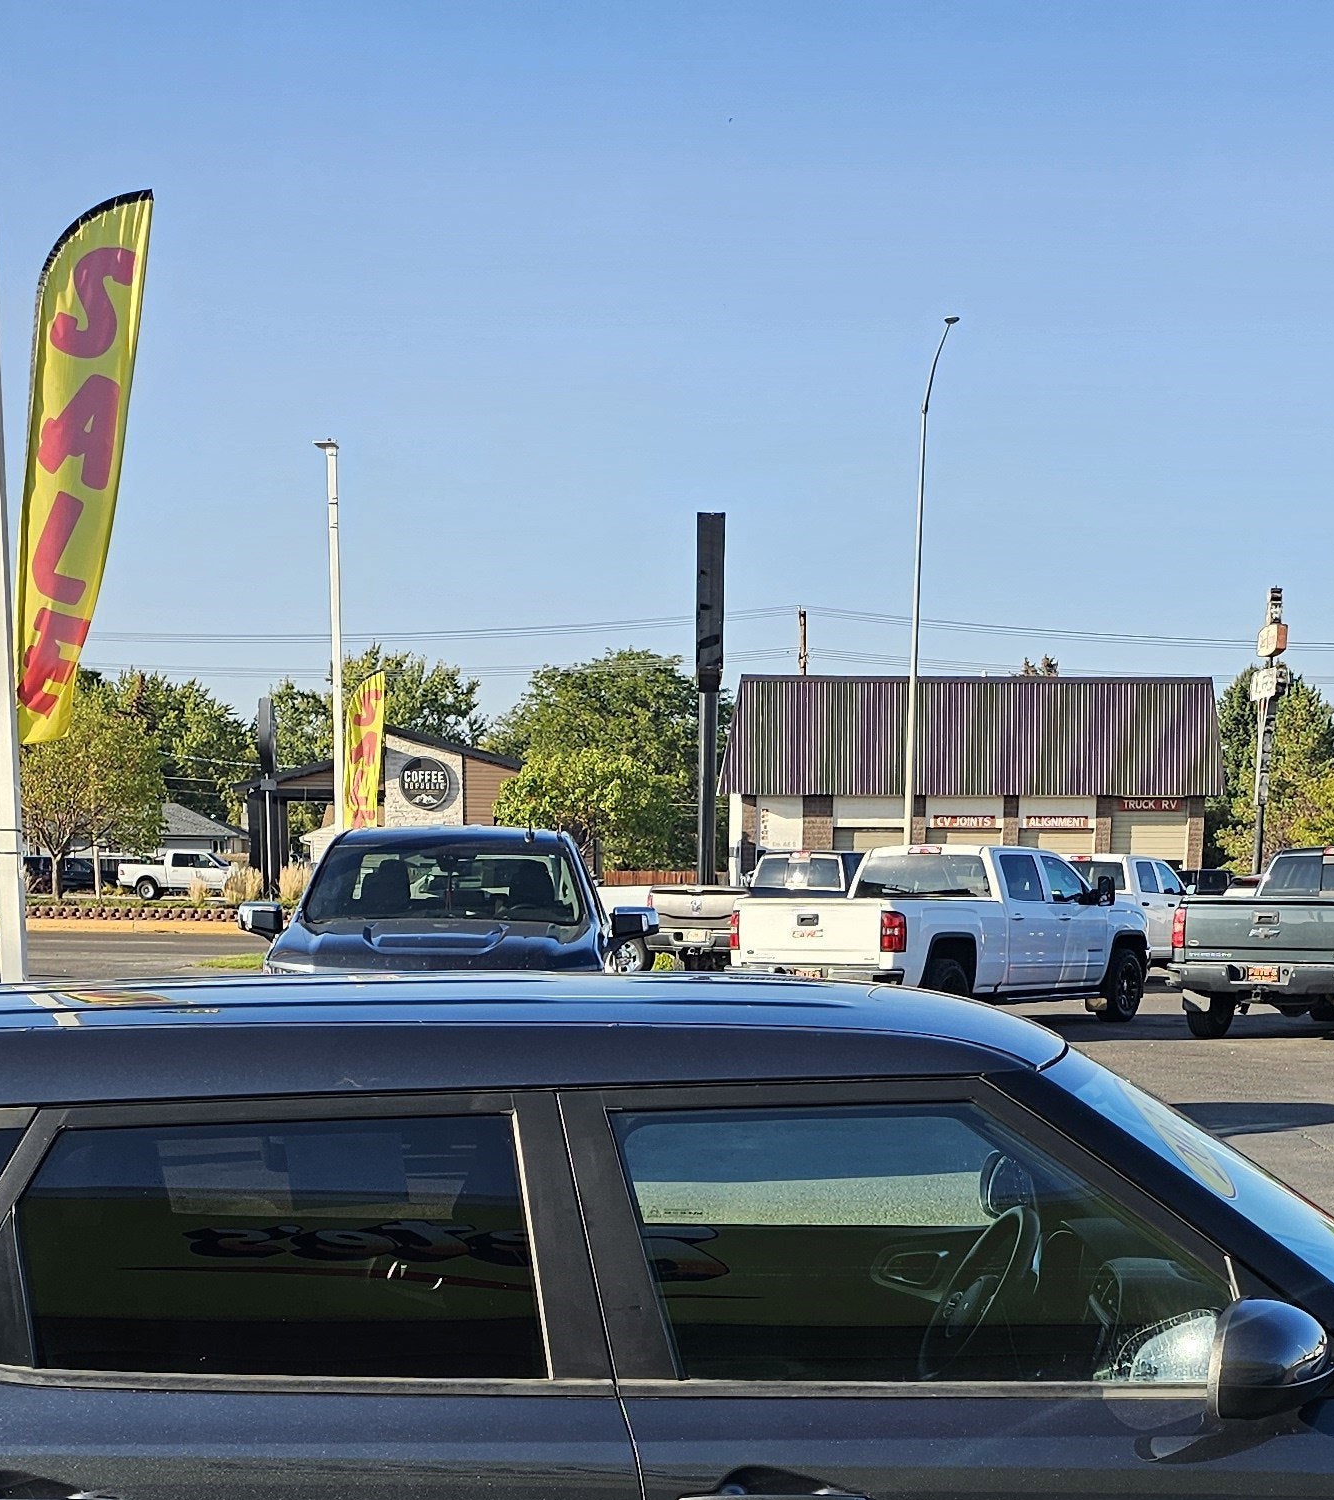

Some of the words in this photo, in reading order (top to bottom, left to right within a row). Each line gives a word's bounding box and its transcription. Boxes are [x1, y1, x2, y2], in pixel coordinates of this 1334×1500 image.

[17, 247, 138, 719] SALE
[403, 770, 445, 783] COFFEE
[1123, 799, 1155, 810] TRUCK
[936, 816, 952, 827] CV
[953, 816, 992, 827] JOINTS
[1028, 816, 1085, 828] ALIGNMENT
